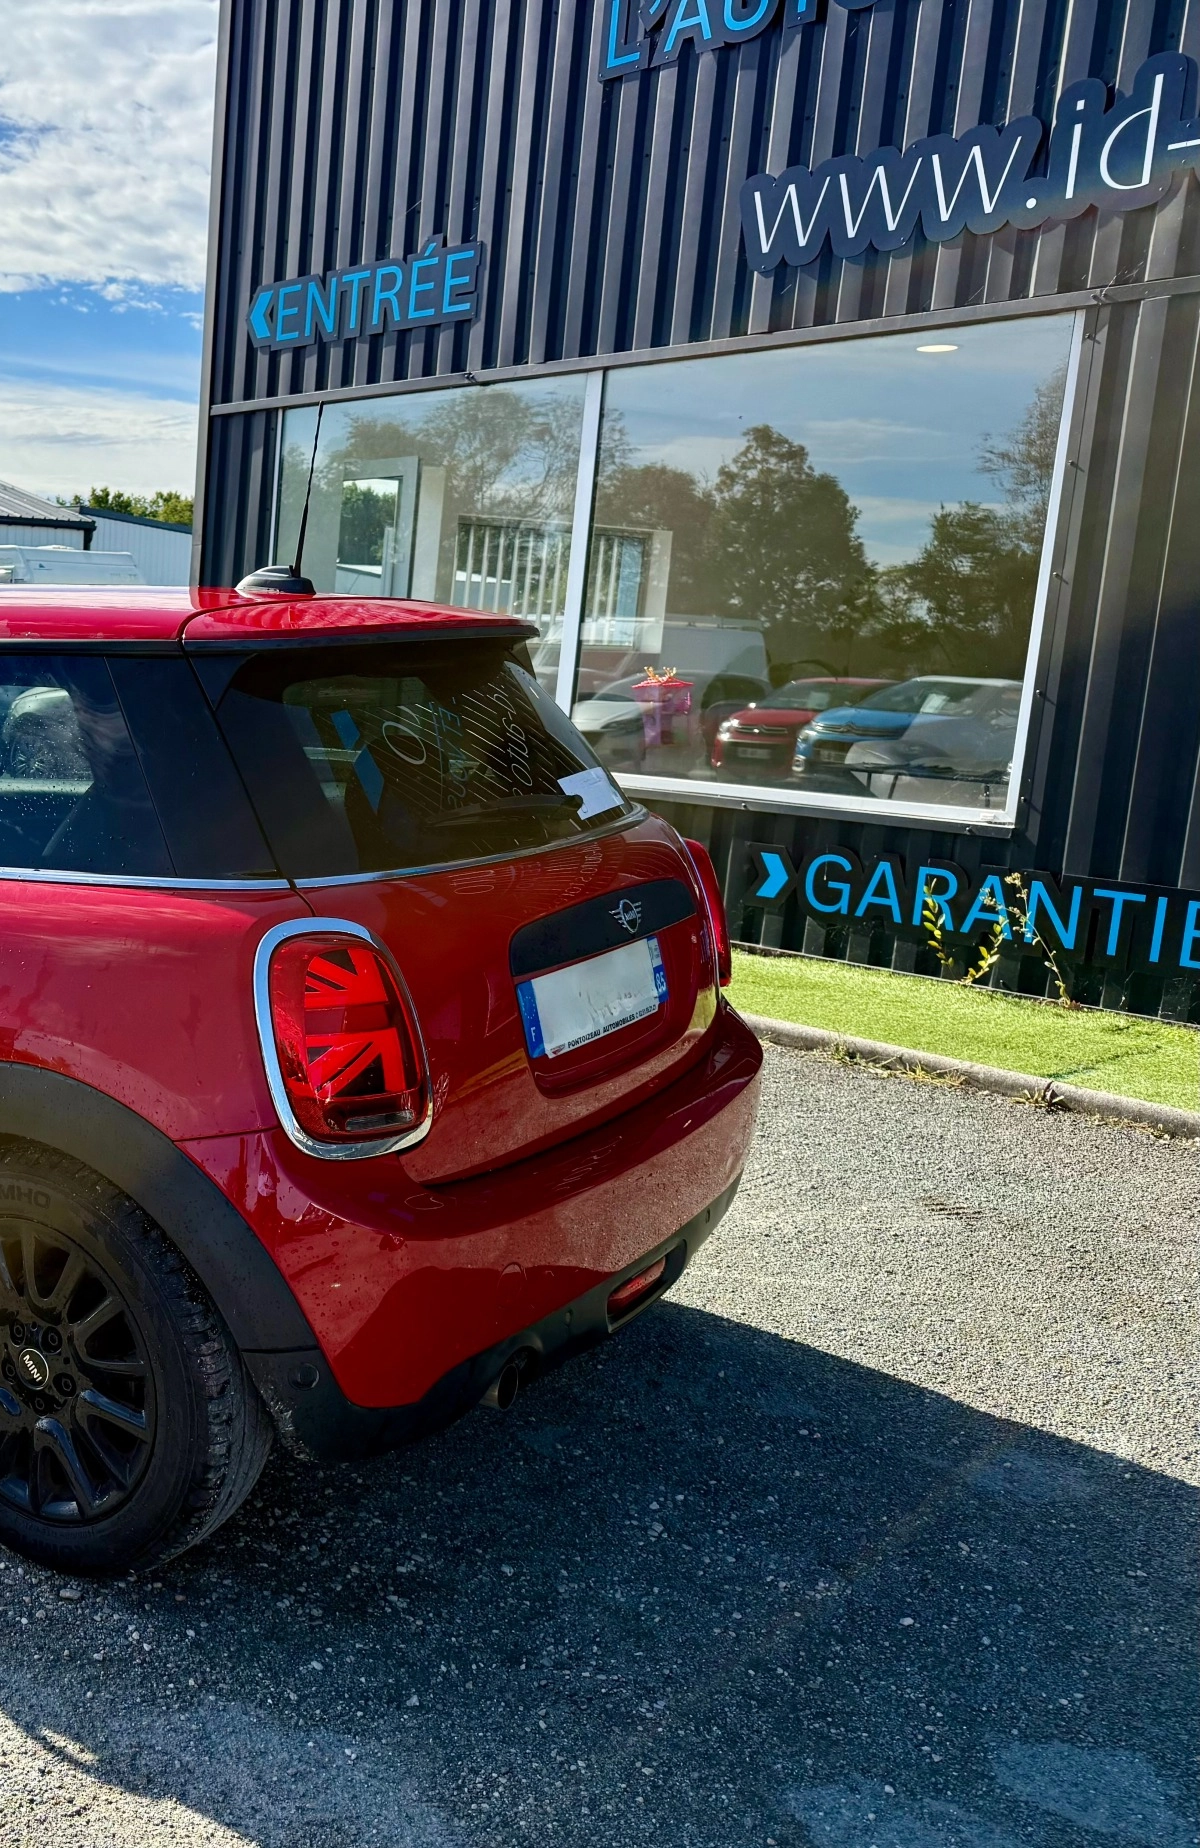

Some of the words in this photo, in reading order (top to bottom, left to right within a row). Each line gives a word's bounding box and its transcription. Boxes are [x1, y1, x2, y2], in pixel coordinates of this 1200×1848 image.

[276, 243, 475, 341] ENTRÉE
[655, 971, 666, 992] 85
[530, 1026, 536, 1042] F
[602, 1013, 636, 1034] AUTOMOBILES
[23, 1354, 43, 1382] MINI
